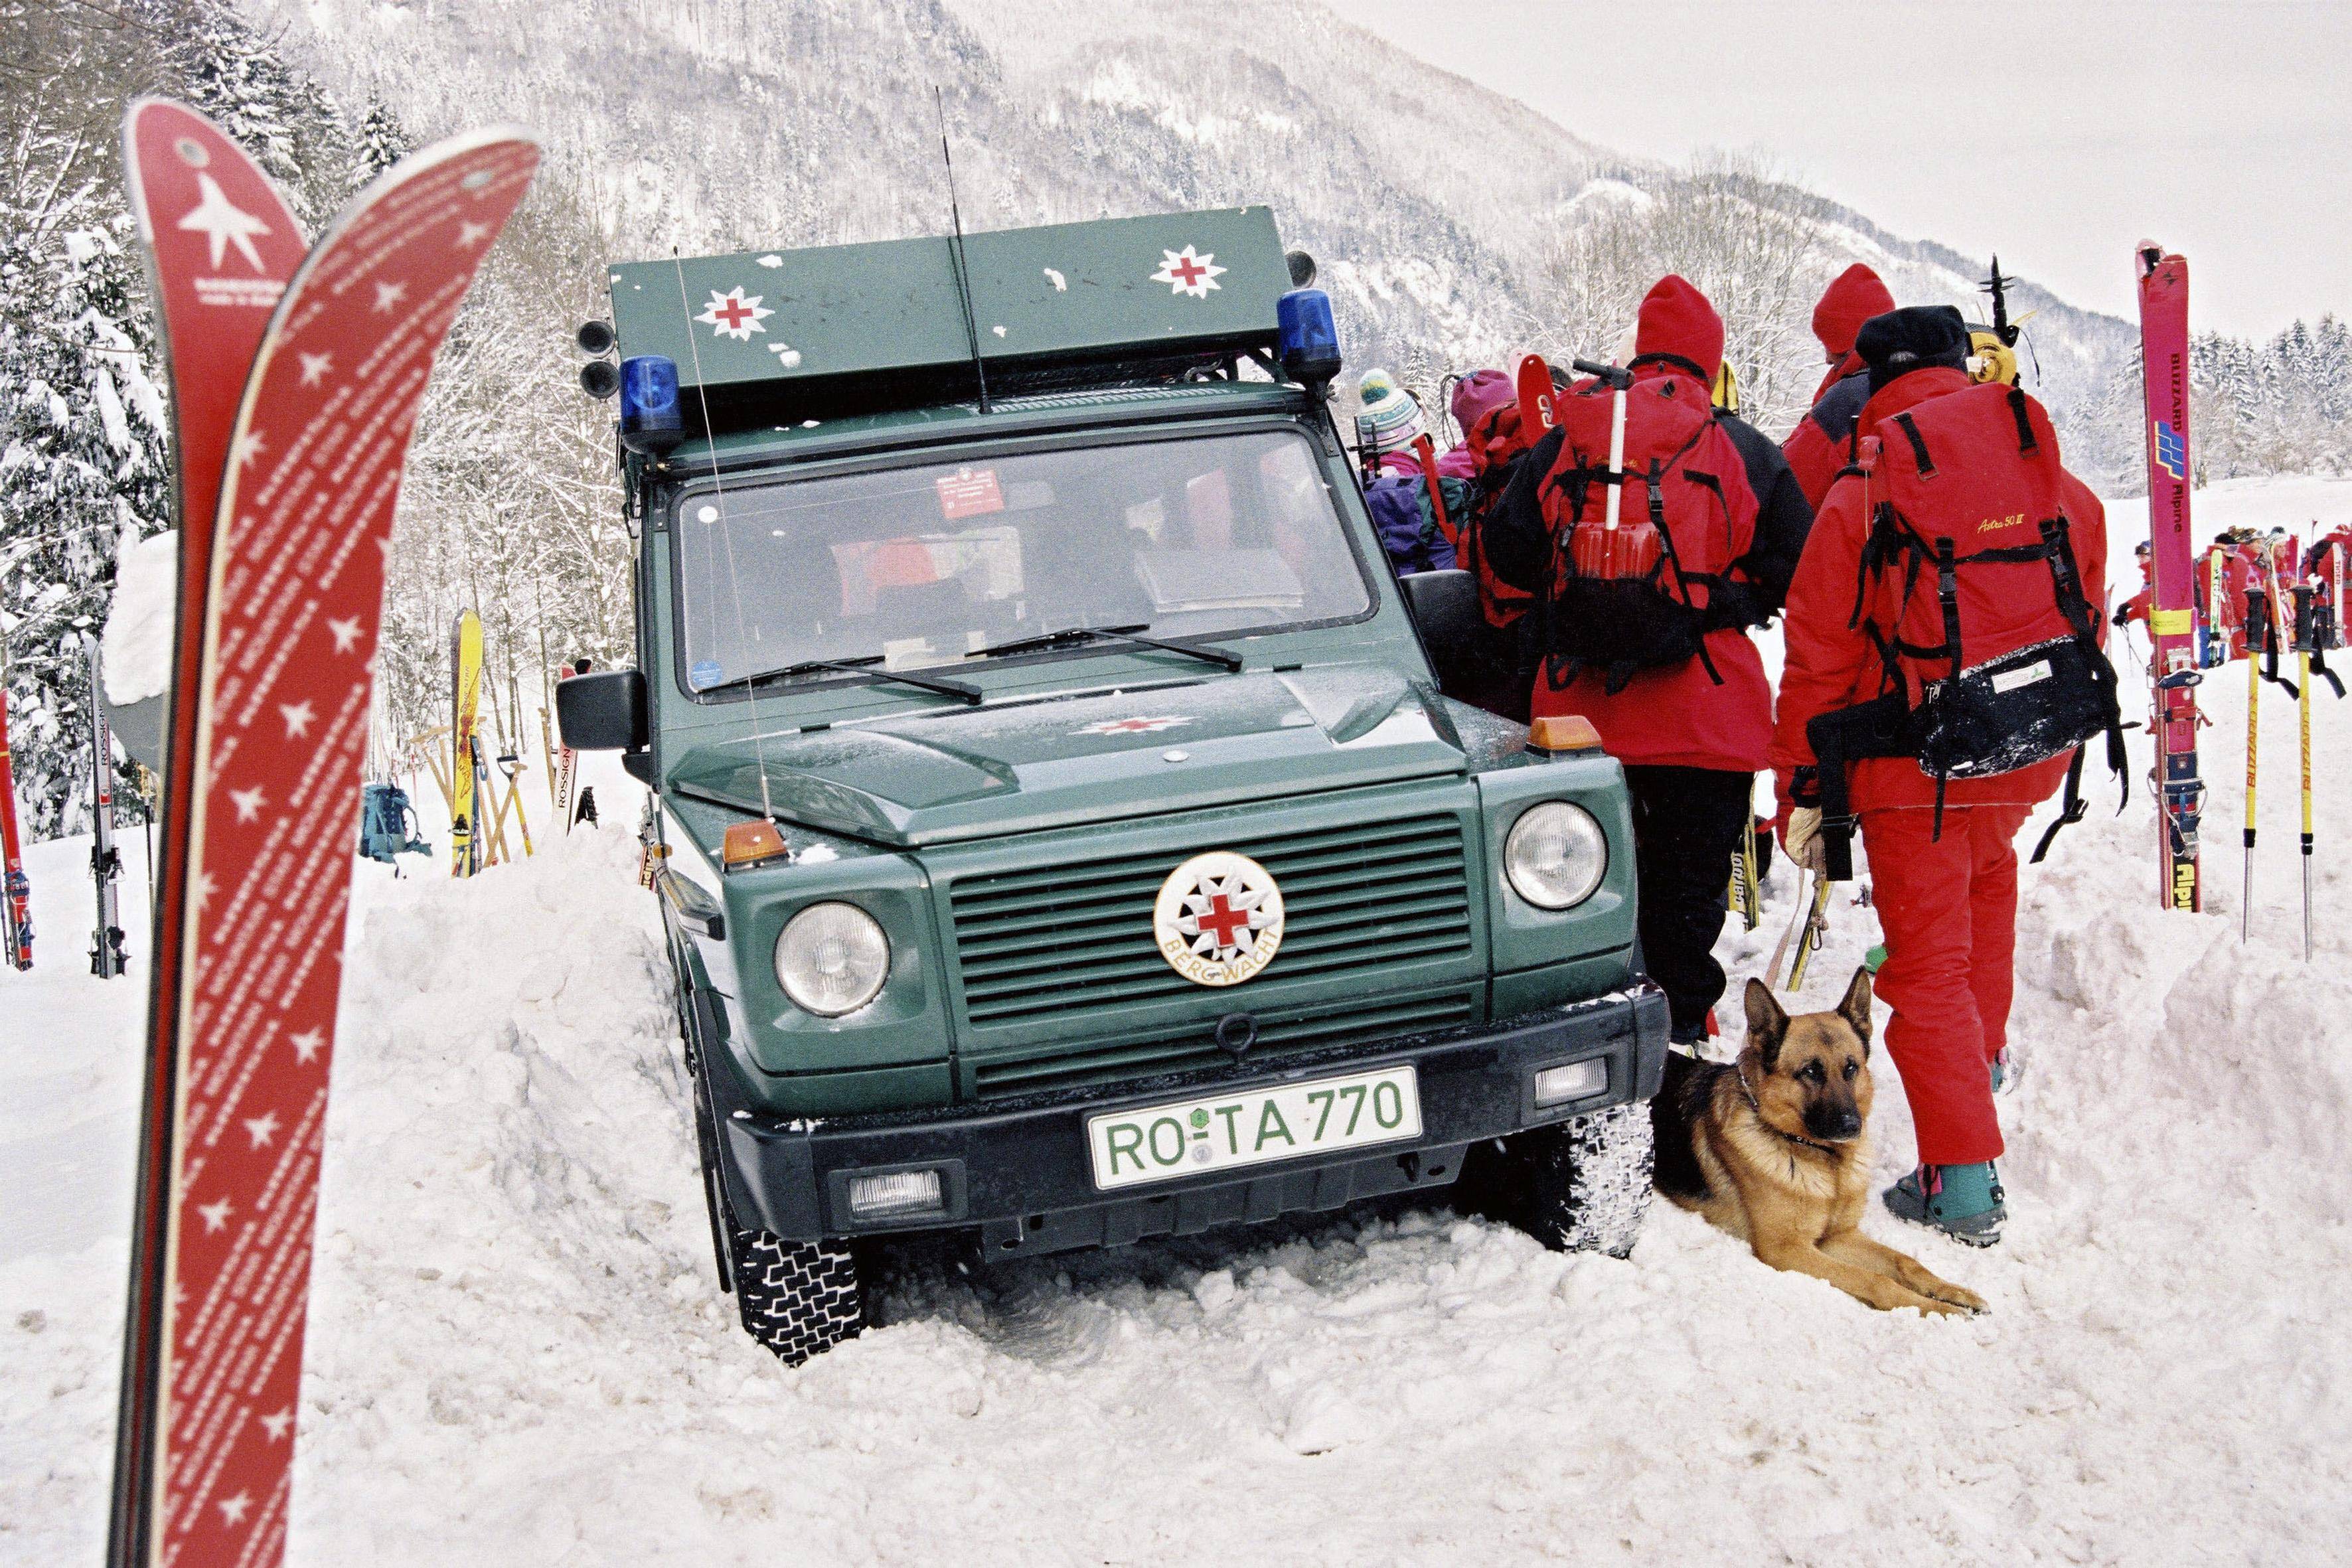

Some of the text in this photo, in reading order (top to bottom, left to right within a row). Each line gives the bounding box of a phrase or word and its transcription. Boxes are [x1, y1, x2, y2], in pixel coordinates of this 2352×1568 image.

[2171, 353, 2183, 533] BLIZZARD Alpine
[1977, 518, 2003, 534] Astra
[2005, 515, 2015, 526] 50
[558, 748, 571, 808] ROSSIGN
[642, 855, 655, 888] Alpi
[1307, 1080, 1404, 1142] 770
